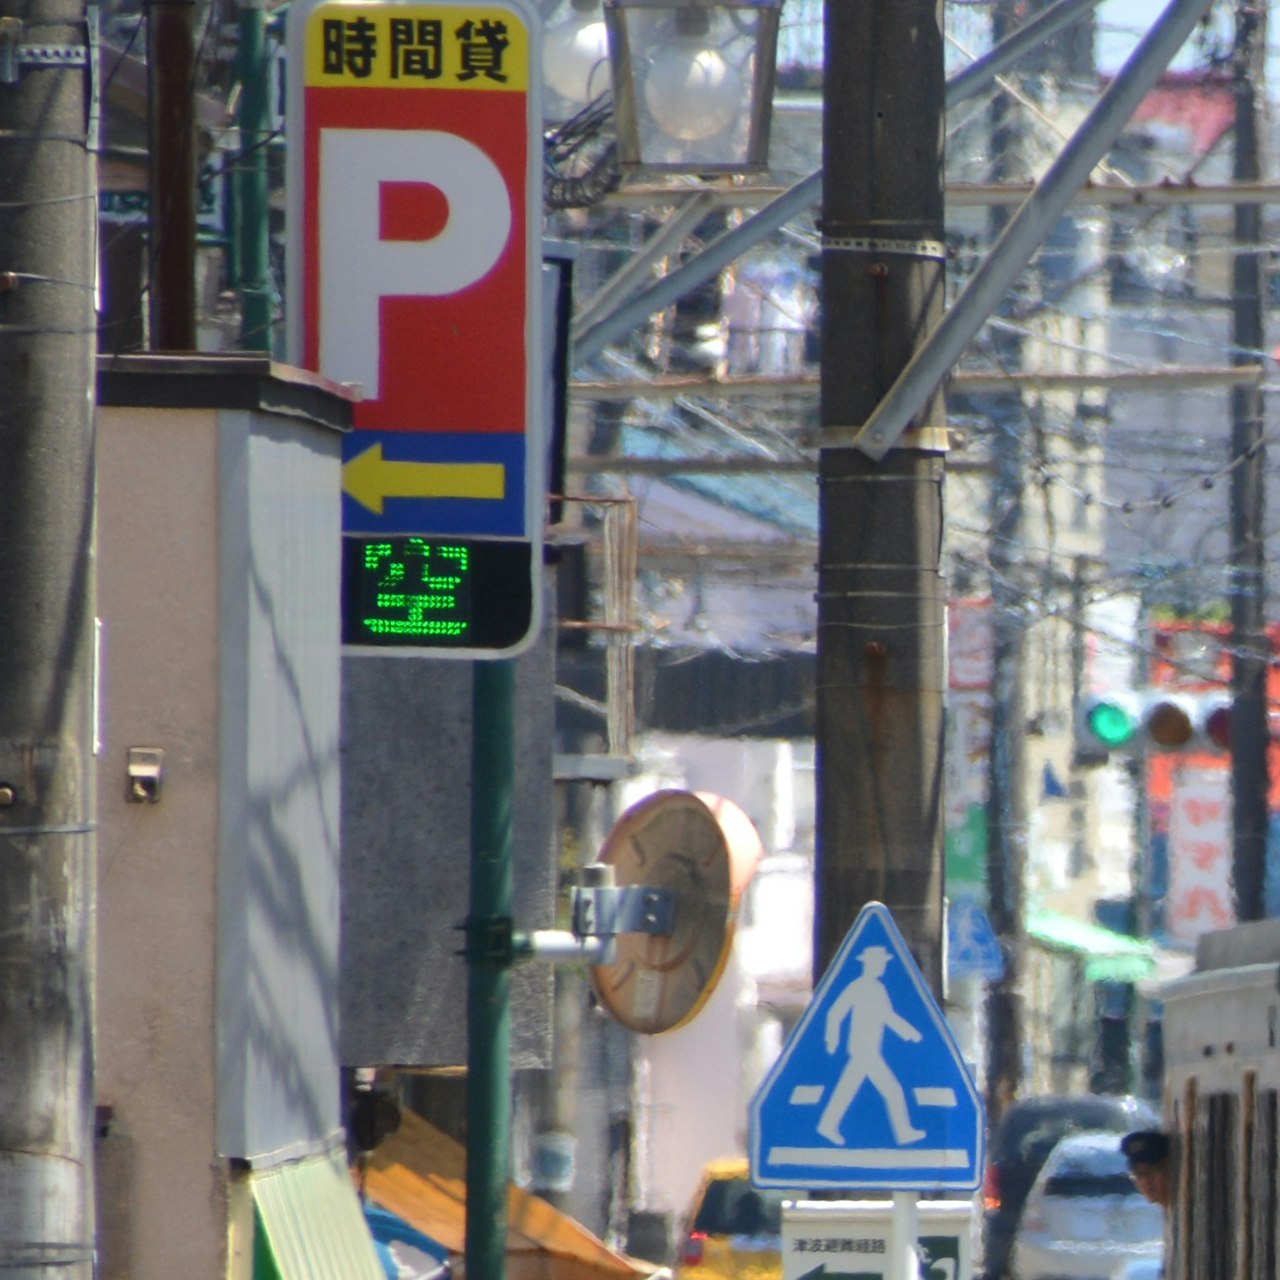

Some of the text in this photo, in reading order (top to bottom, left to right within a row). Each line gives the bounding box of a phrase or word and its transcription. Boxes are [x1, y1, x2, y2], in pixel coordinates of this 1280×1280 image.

[322, 17, 510, 83] 時間貸
[319, 128, 512, 400] P
[364, 538, 468, 636] 空
